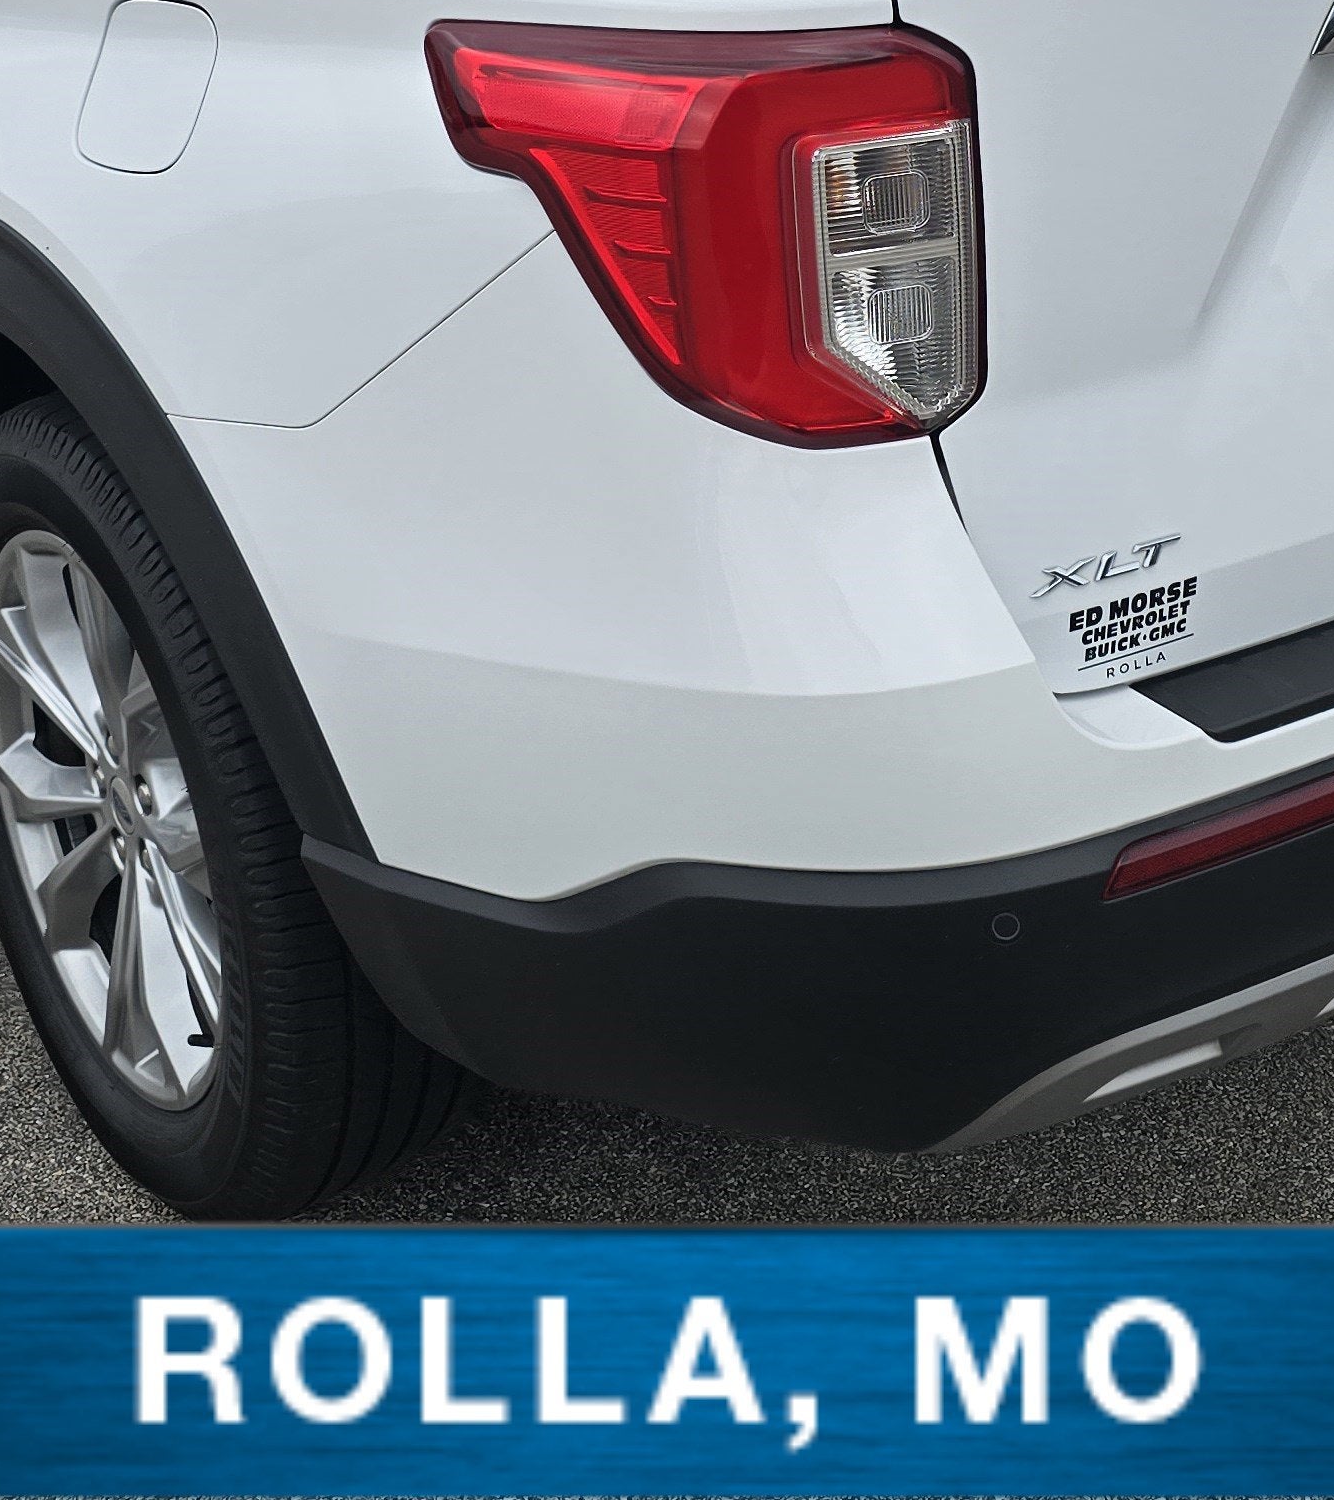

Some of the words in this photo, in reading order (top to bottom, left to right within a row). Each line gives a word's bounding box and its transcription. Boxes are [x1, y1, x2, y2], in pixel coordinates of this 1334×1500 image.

[1028, 533, 1182, 599] XLT
[1068, 605, 1104, 633] ED
[1108, 576, 1198, 621] MORSE
[1081, 599, 1191, 646] CHEVROLET
[1106, 651, 1167, 679] ROLLA
